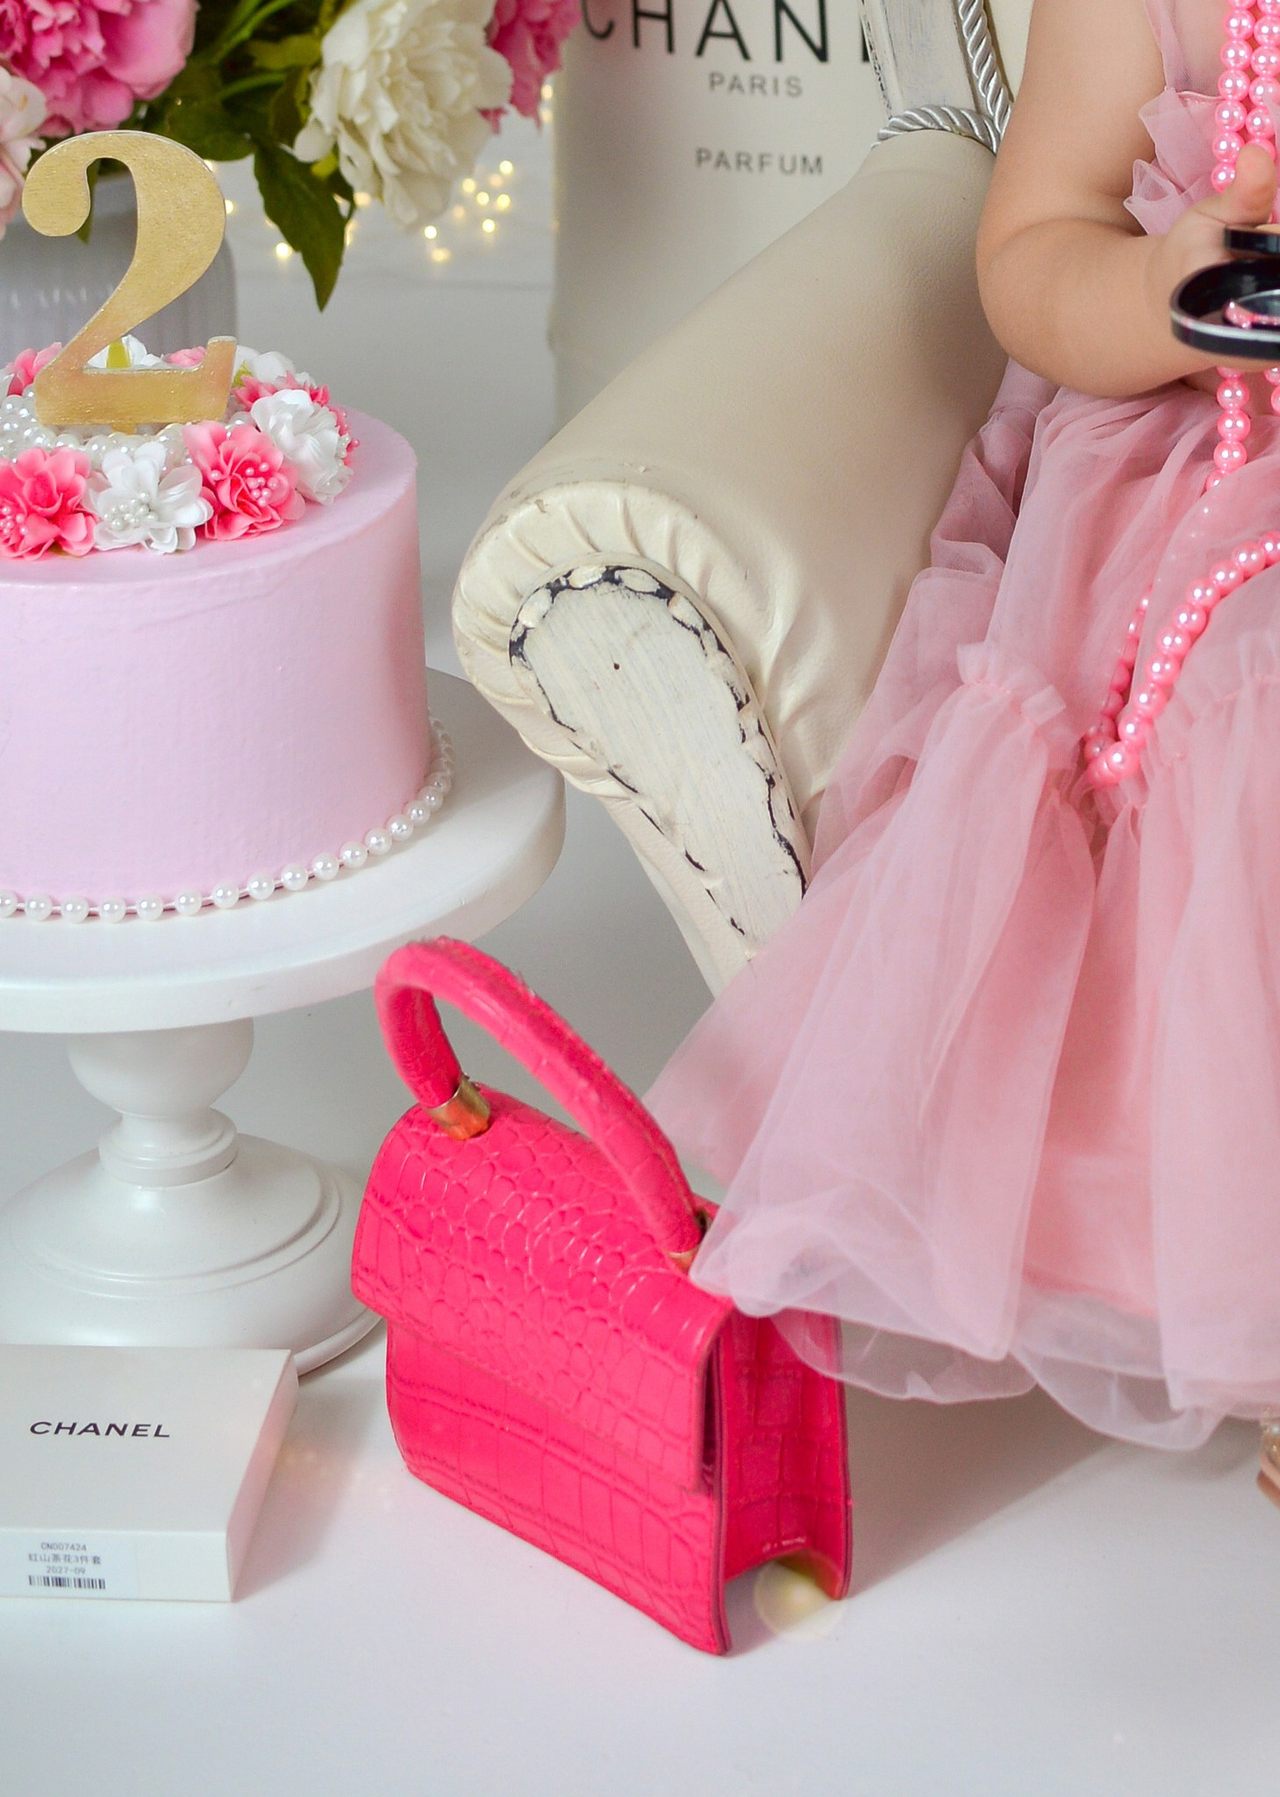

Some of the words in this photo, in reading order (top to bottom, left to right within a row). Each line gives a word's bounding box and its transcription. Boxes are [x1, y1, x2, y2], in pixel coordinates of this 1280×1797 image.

[708, 71, 803, 97] PARIS
[695, 146, 824, 176] PARFUM
[21, 129, 237, 426] 2
[29, 1421, 171, 1438] CHANEL
